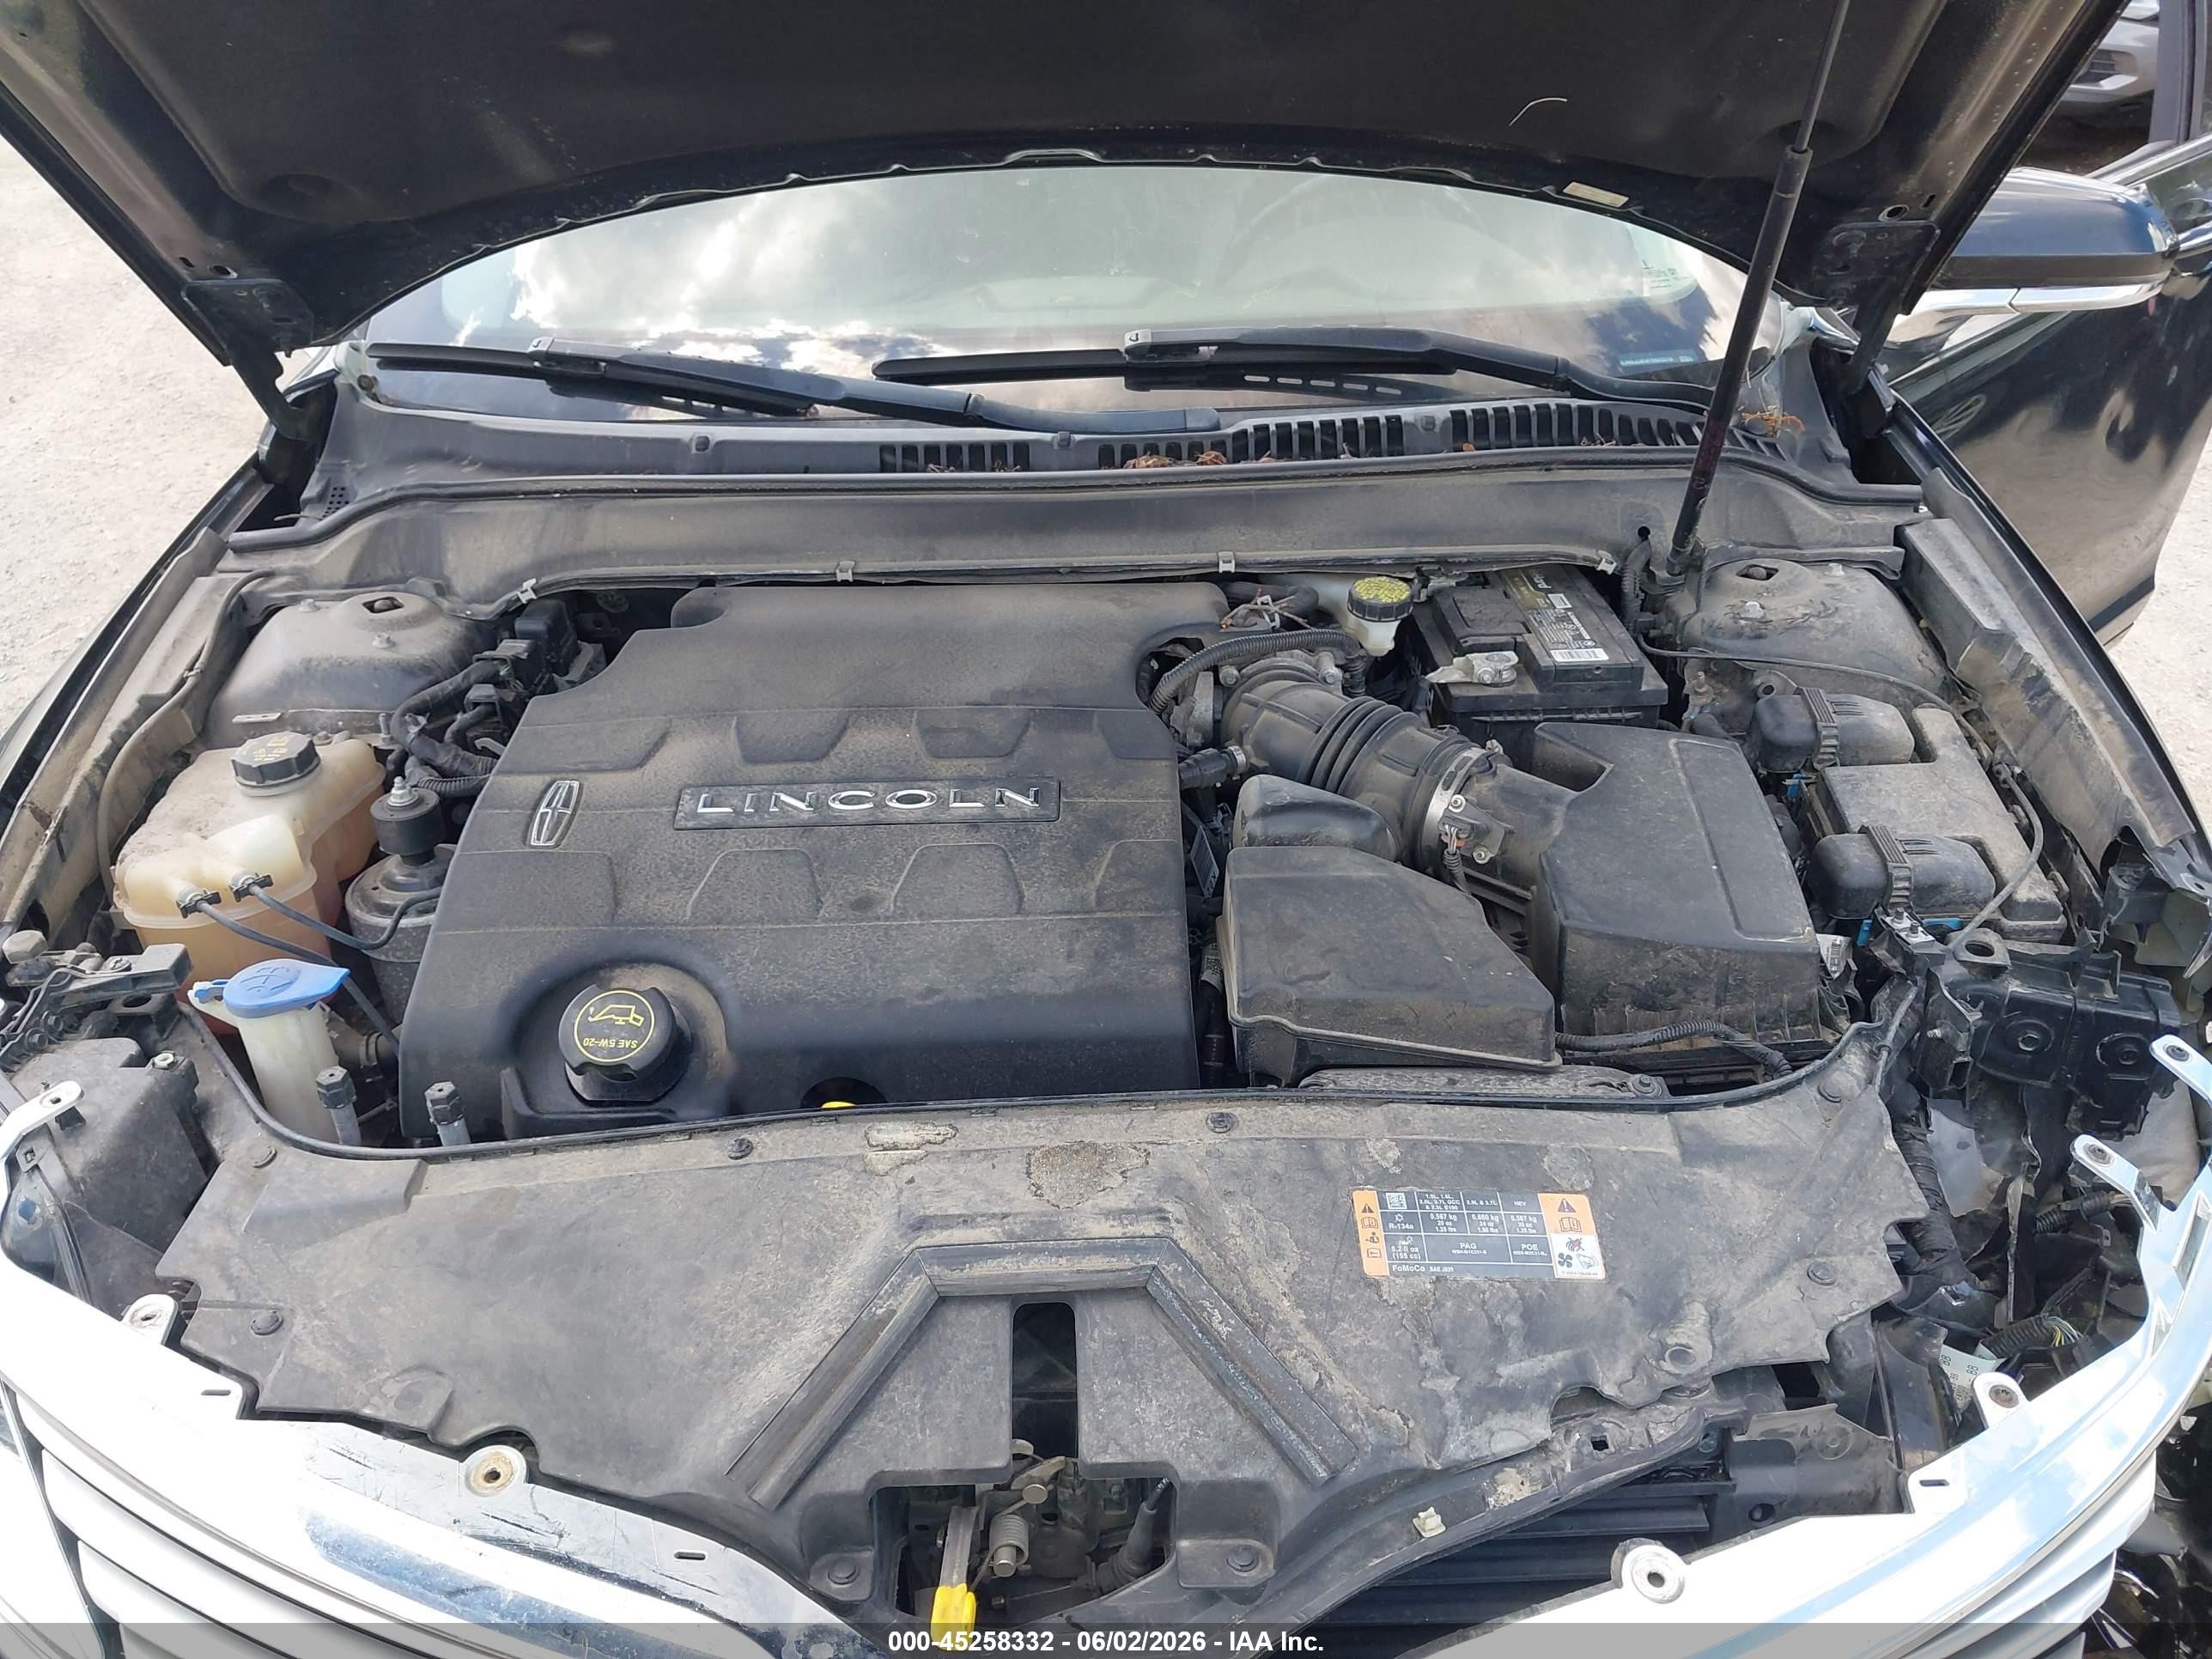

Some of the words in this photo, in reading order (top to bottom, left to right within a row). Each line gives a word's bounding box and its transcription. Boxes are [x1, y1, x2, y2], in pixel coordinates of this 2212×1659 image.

[696, 787, 1040, 813] LINCOLN
[583, 1037, 616, 1048] 5W-20
[618, 1039, 638, 1048] SAE
[1449, 1213, 1457, 1222] kg
[1491, 1213, 1499, 1223] kg
[1528, 1215, 1537, 1224] kg
